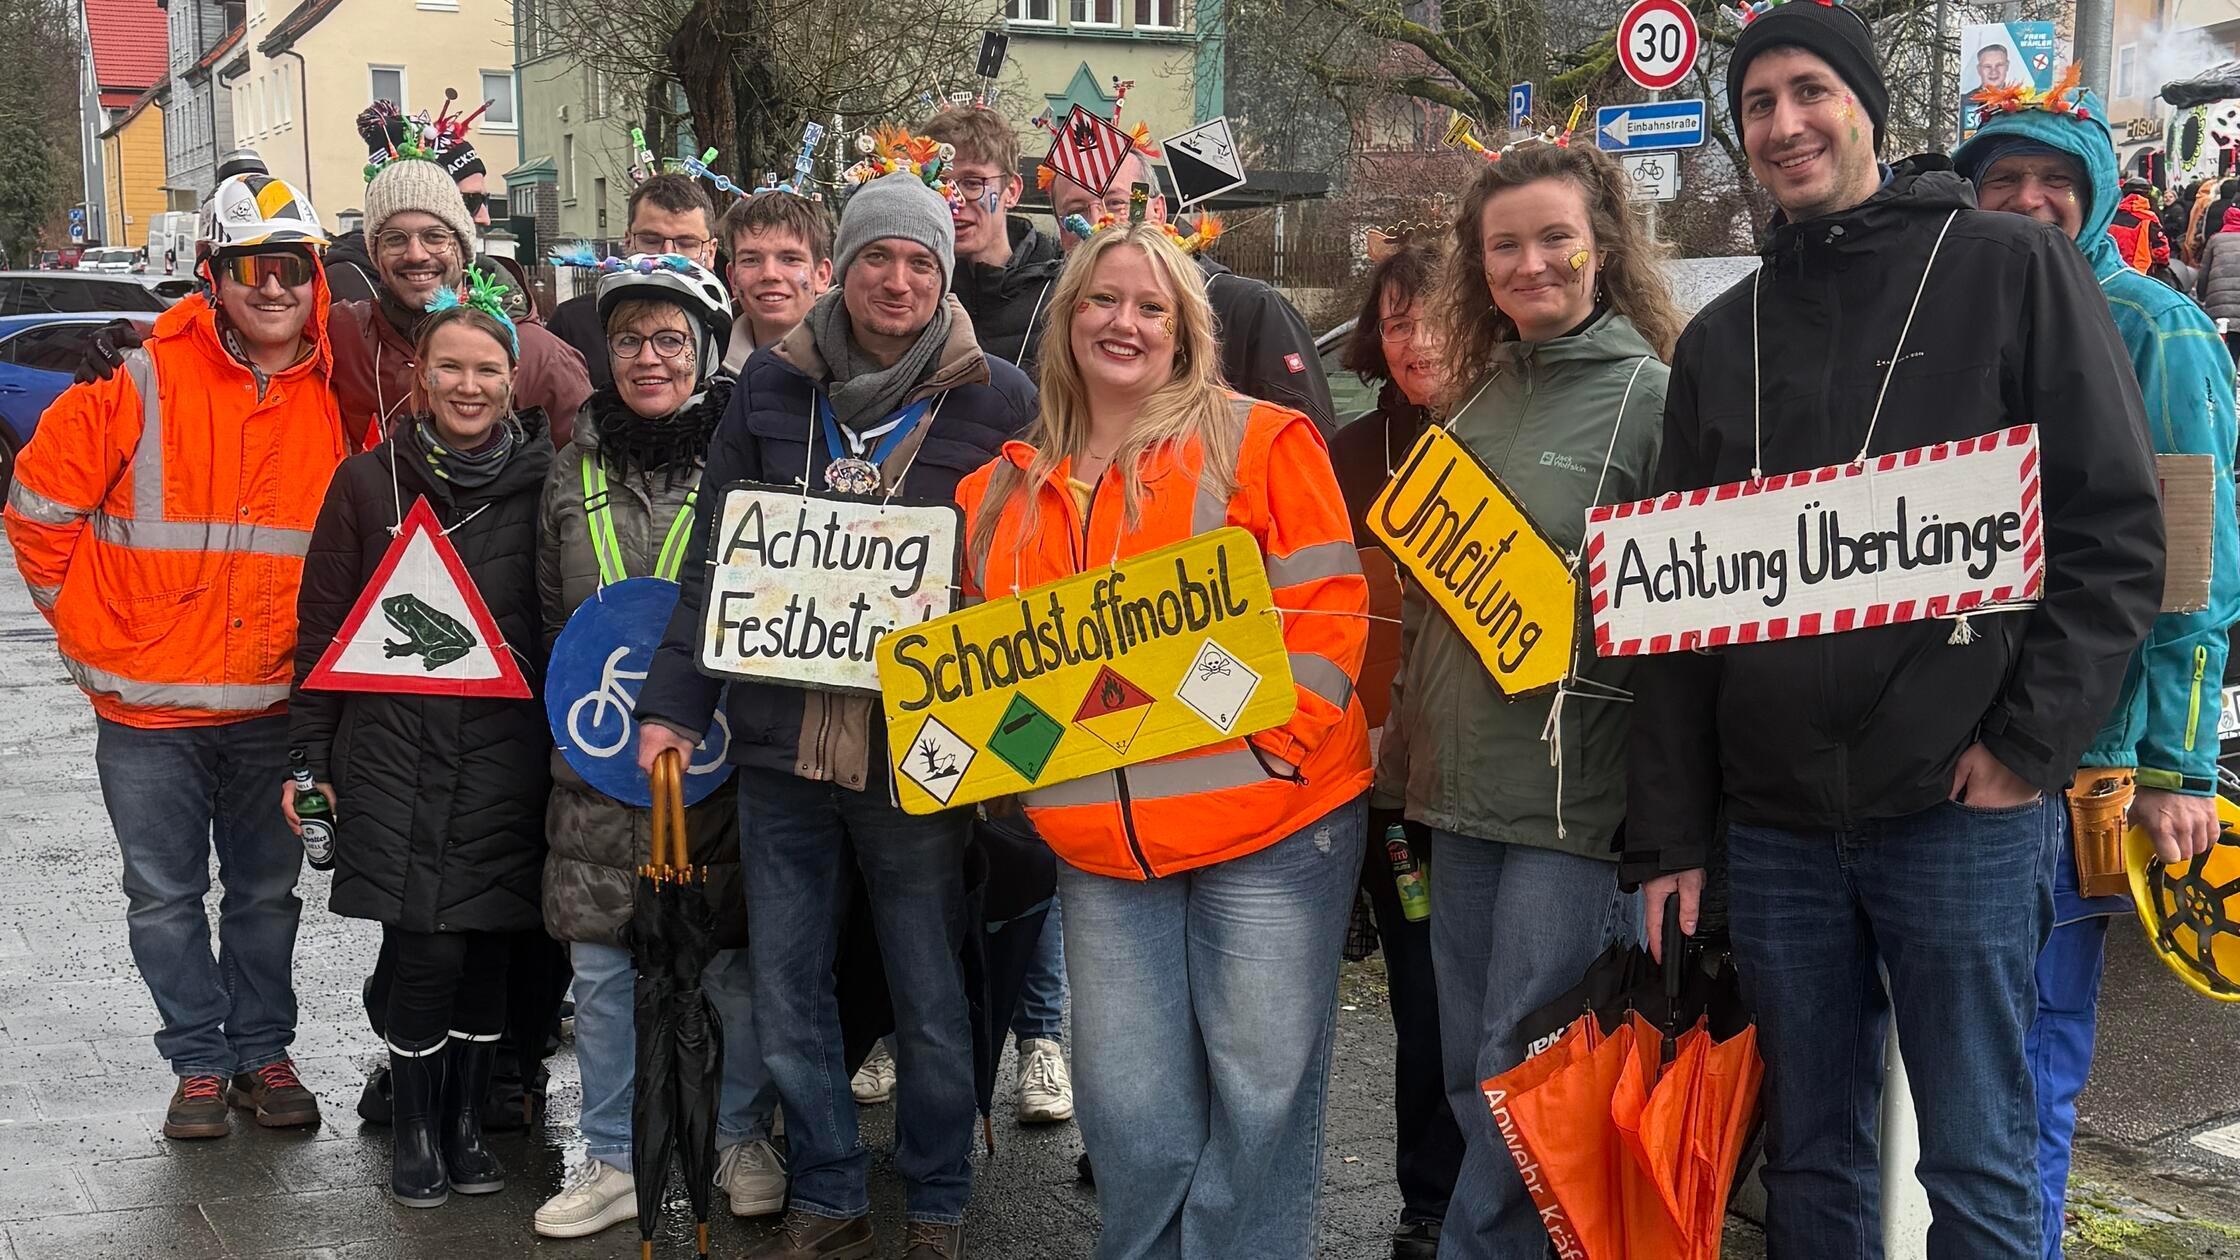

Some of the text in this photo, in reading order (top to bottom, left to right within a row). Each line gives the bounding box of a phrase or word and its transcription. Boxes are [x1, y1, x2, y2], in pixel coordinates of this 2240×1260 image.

[1636, 23, 1681, 62] 30
[1513, 91, 1525, 128] P
[1627, 118, 1697, 133] Einbahnstraße
[723, 500, 930, 598] Achtung
[1381, 433, 1542, 673] Umleitung
[1614, 496, 2021, 607] Achtung Überlänge
[893, 543, 1249, 711] Schadstoffmobil
[1221, 713, 1226, 723] 6
[1484, 1089, 1544, 1195] Anwehr
